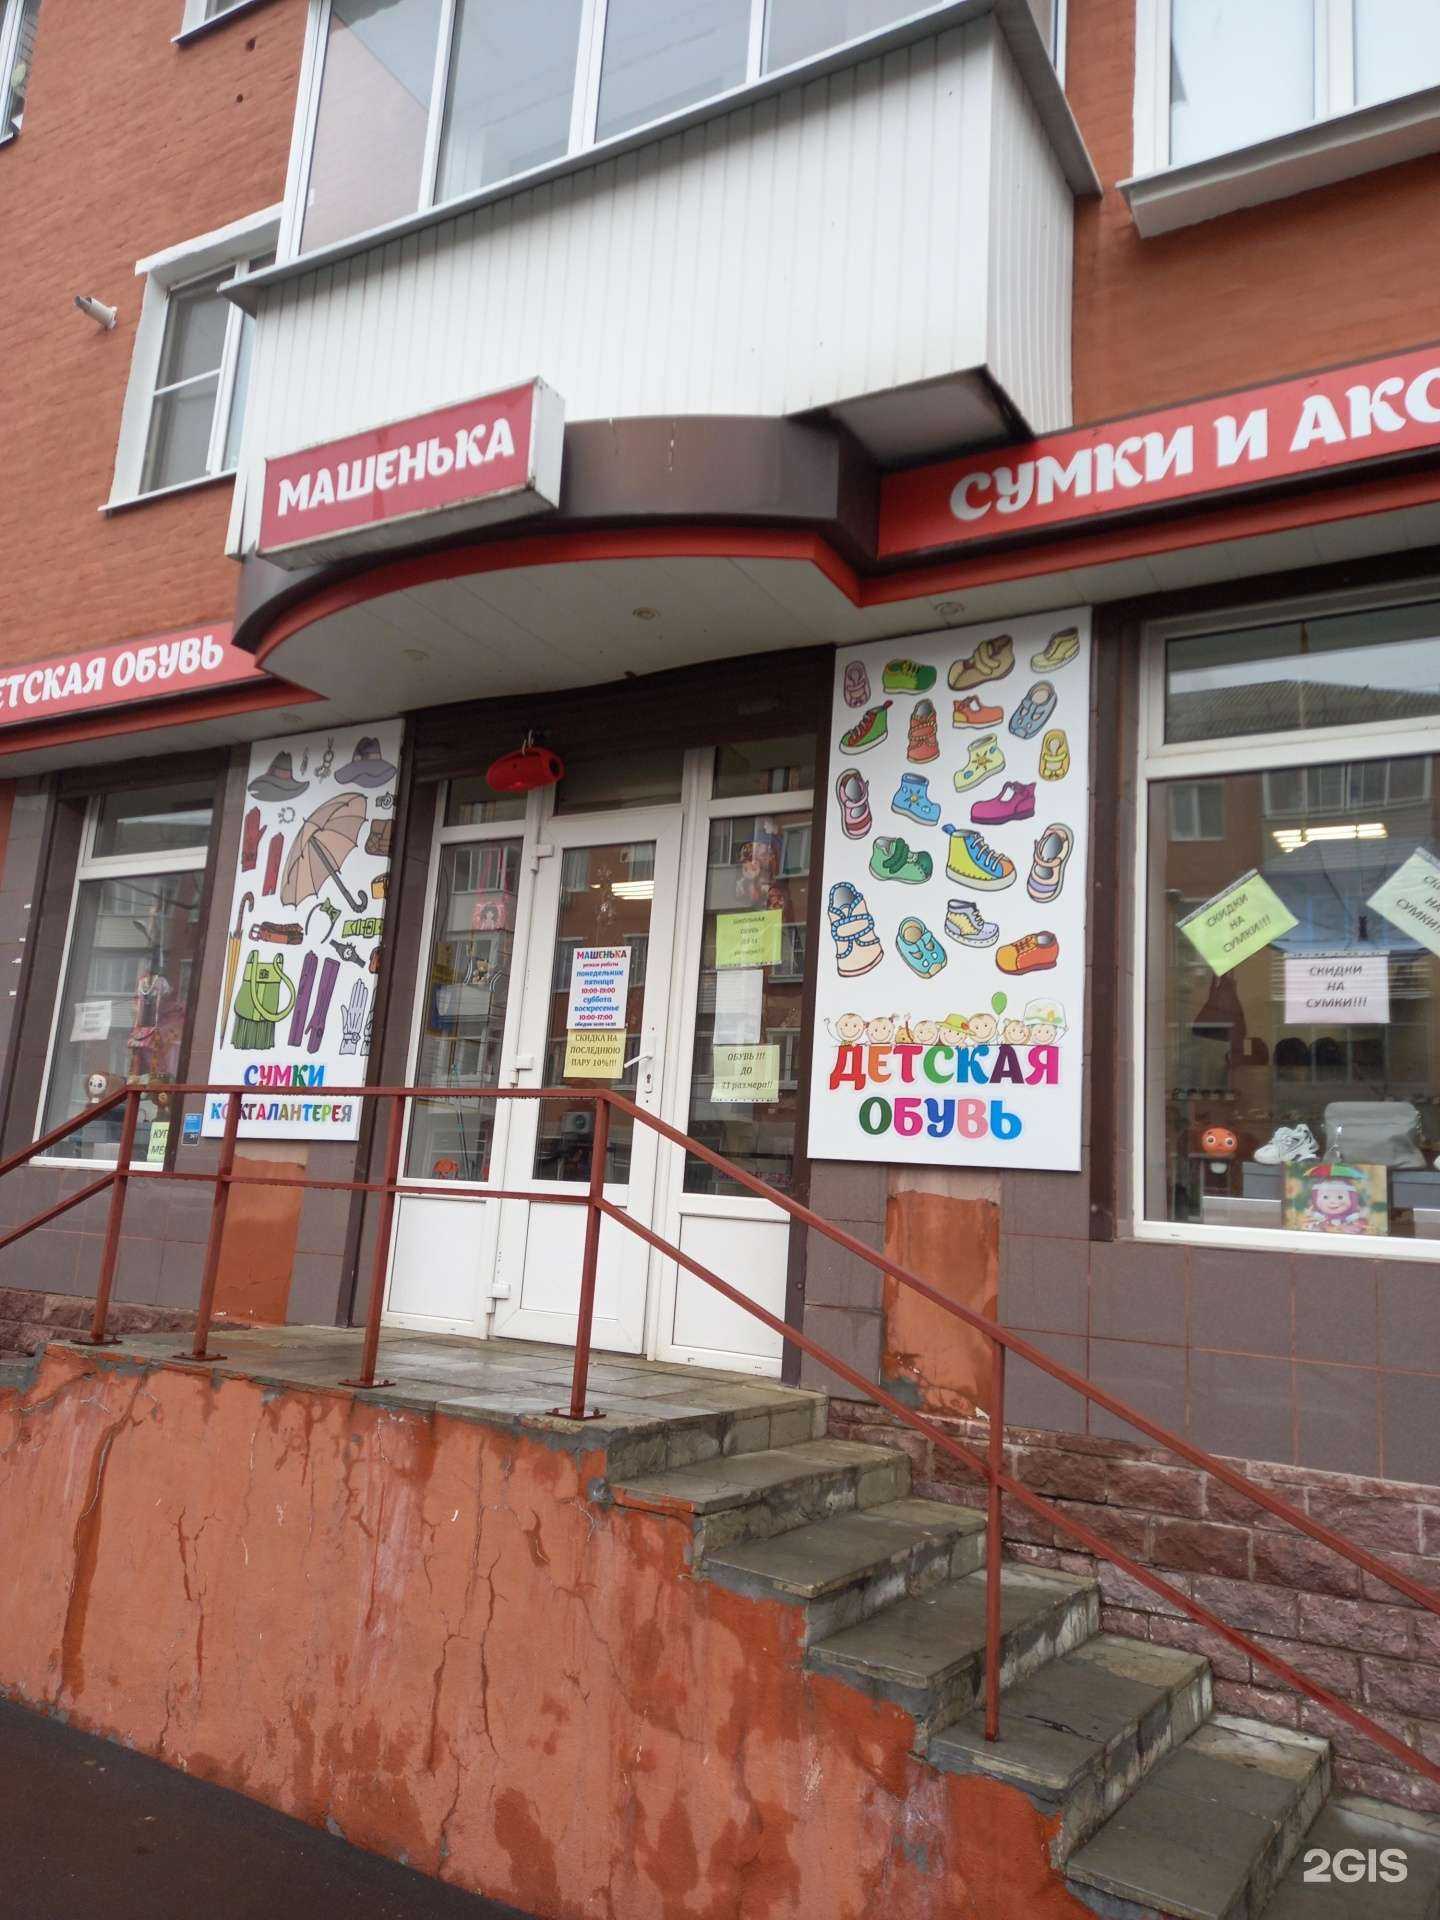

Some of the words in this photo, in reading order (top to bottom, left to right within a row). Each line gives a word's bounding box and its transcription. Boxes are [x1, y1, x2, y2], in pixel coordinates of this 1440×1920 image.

[950, 424, 1194, 521] СУМКИ
[1213, 408, 1268, 468] И
[1289, 367, 1440, 452] АКС
[277, 418, 515, 517] МАШЕНЬКА
[112, 635, 224, 687] ОБУВЬ
[1207, 894, 1248, 927] СКИДКИ
[1230, 916, 1246, 930] НА
[576, 950, 627, 960] МАШЕНЬКА
[1309, 965, 1363, 977] СКИДКИ
[1327, 981, 1345, 991] НА
[583, 995, 612, 1004] суббота
[575, 1034, 605, 1043] СКИДКА
[607, 1034, 618, 1042] НА
[570, 1046, 621, 1055] ПОСЛЕДНЮЮ
[571, 1058, 591, 1067] ПАРУ
[829, 1044, 1060, 1090] ДЕТСКАЯ
[244, 1064, 325, 1088] СУМКИ
[858, 1096, 1022, 1140] ОБУВЬ
